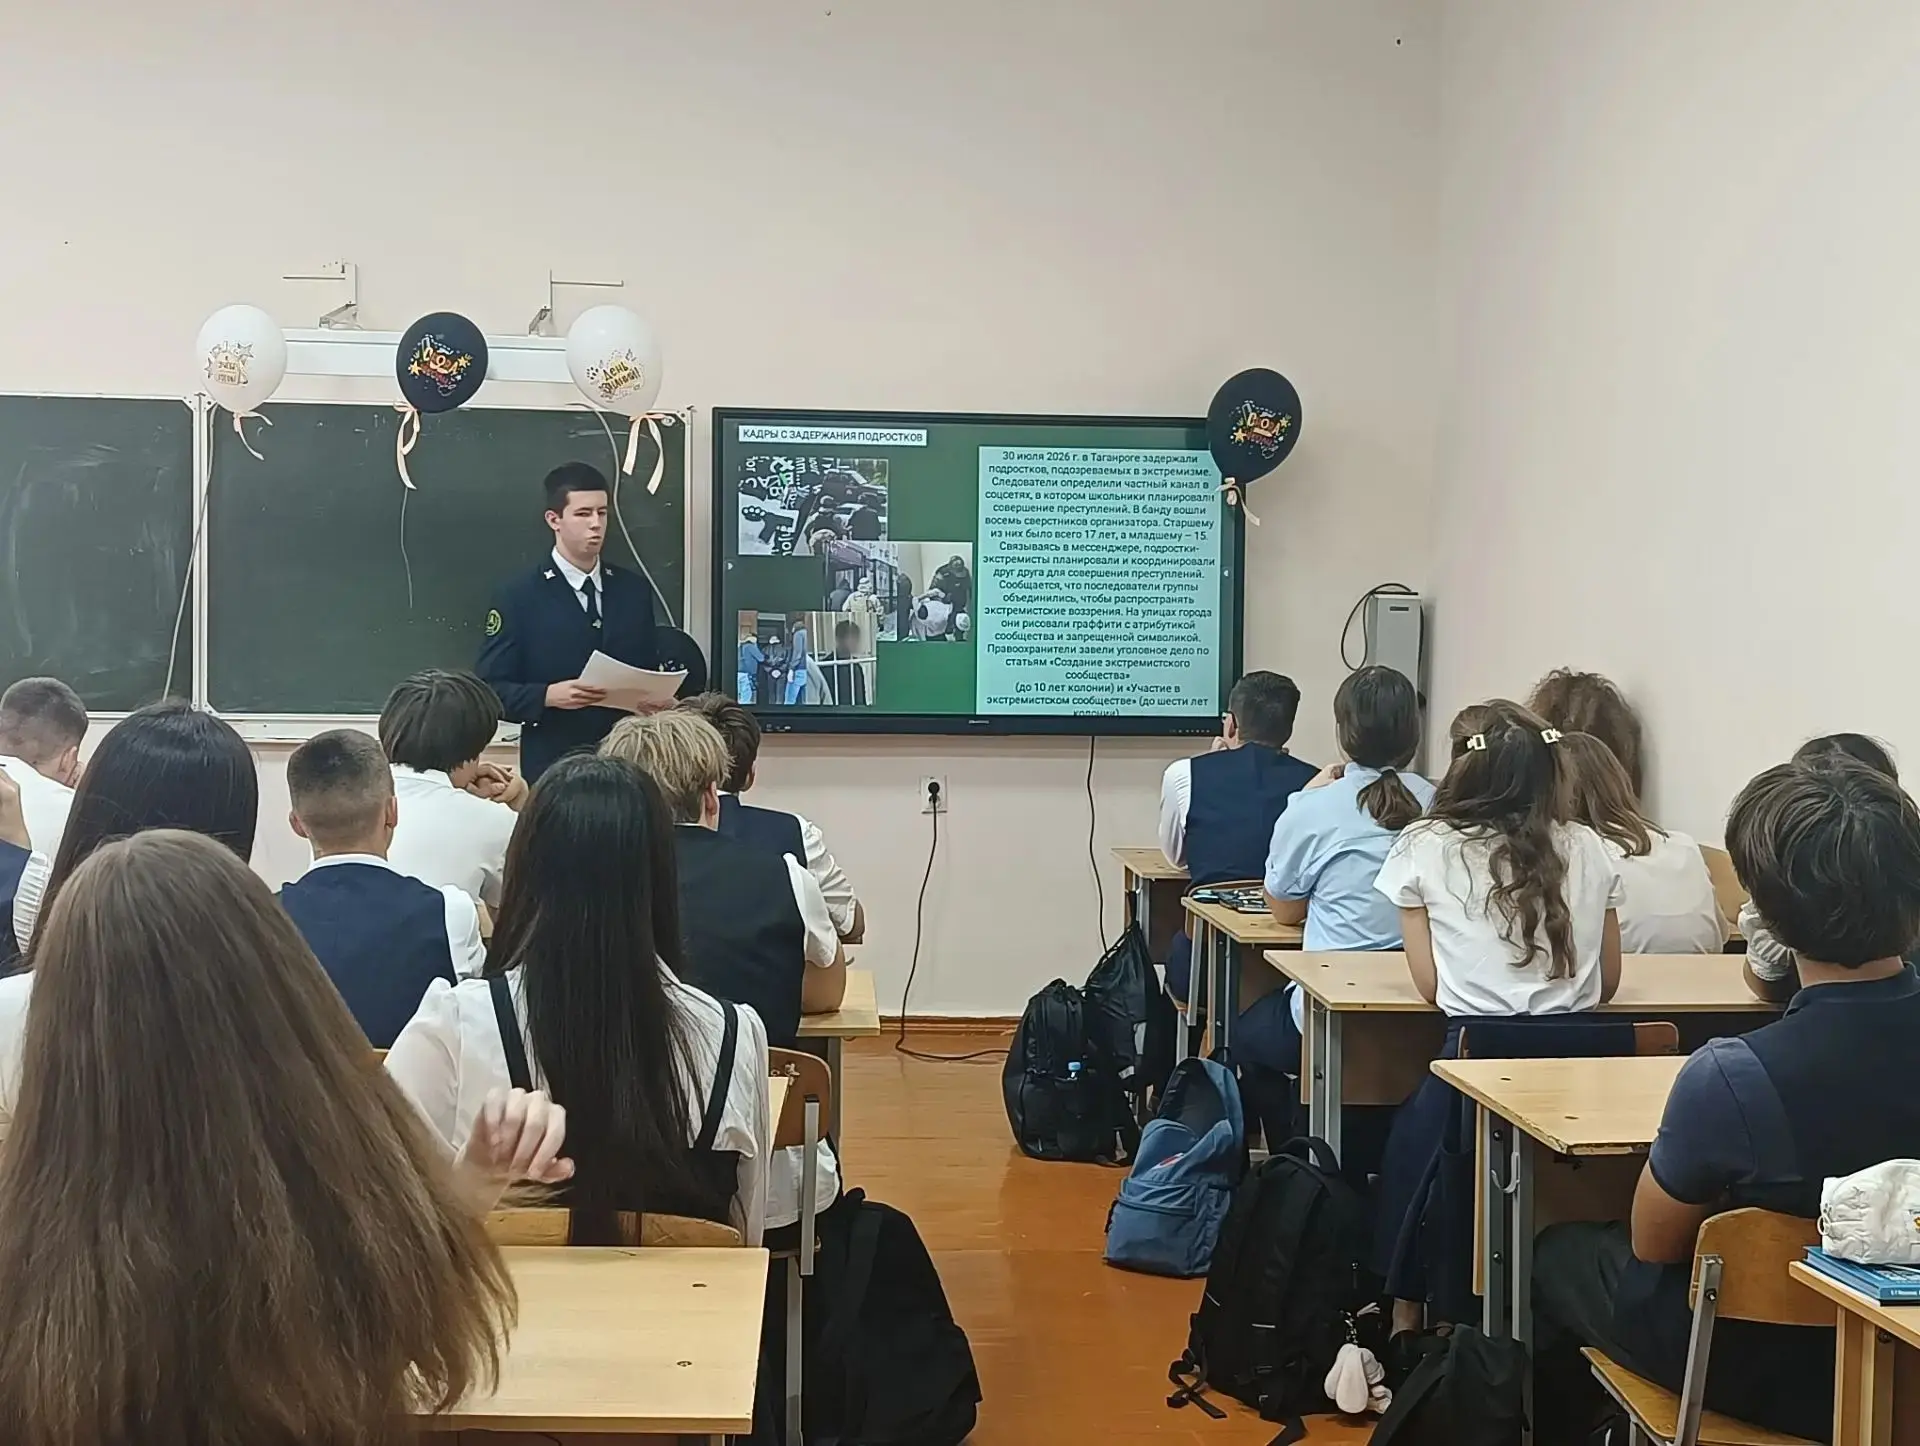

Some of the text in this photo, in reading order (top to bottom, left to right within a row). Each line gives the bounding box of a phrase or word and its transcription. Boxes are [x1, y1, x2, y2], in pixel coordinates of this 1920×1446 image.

[742, 428, 923, 443] КАДРЫ С ЗАДЕРЖАНИЯ ПОДРОСТКОВ
[1001, 450, 1015, 460] 30
[1016, 452, 1044, 461] июля
[1045, 451, 1070, 462] 2026
[1089, 451, 1142, 465] Таганроге
[1141, 454, 1198, 466] задержали
[987, 465, 1212, 479] подростков, подозреваемых в экстремизме.
[990, 476, 1211, 490] Следователи определили частный канал в
[984, 490, 1215, 505] соцсетях, в котором школьники планировали
[992, 503, 1206, 516] совершение преступлений. В банду вошли
[984, 516, 1214, 530] восемь сверстников организатора. Старшему
[989, 529, 1003, 538] из
[1004, 530, 1024, 538] них
[1024, 528, 1053, 538] было
[1053, 530, 1083, 539] всего
[1082, 529, 1096, 539] 17
[1095, 531, 1119, 541] лет,
[1119, 531, 1127, 539] а
[1128, 531, 1183, 542] младшему
[998, 541, 1061, 551] Связываясь
[1061, 543, 1069, 551] в
[1070, 543, 1142, 554] мессенджере,
[982, 555, 1215, 567] экстремисты планировали и координировали
[992, 568, 1205, 580] друг друга для совершения преступлений.
[998, 579, 1198, 593] Сообщается, что последователи группы
[1002, 592, 1195, 606] объединились, чтобы распространять
[983, 606, 1212, 619] экстремистские воззрения. На улицах города
[1000, 618, 1196, 631] они рисовали граффити с атрибутикой
[993, 630, 1201, 643] сообщества и запрещенной символикой.
[986, 643, 1210, 657] Правоохранители завели уголовное дело по
[1004, 658, 1047, 666] статьям
[1104, 659, 1192, 670] экстремистского
[1014, 681, 1033, 693] (до
[1032, 681, 1046, 691] 10
[1046, 683, 1066, 692] лет
[1066, 682, 1115, 694] колонии)
[1116, 684, 1124, 692] и
[1173, 684, 1180, 693] в
[985, 696, 1070, 707] экстремистском
[1138, 695, 1156, 707] (до
[1156, 697, 1188, 705] шести
[1189, 697, 1208, 706] лет
